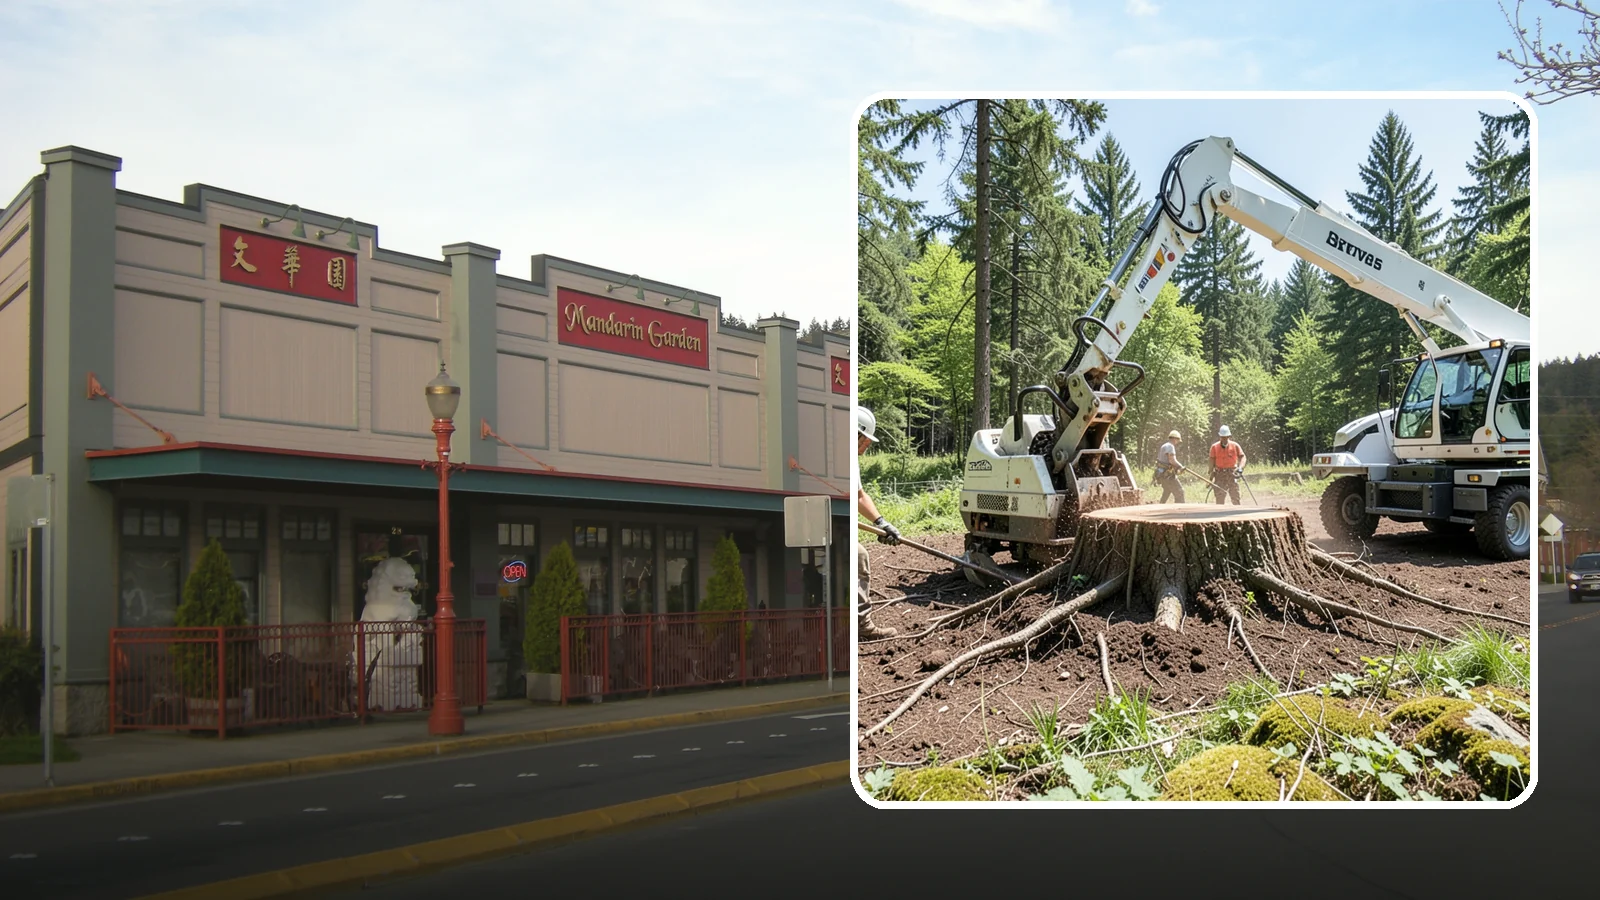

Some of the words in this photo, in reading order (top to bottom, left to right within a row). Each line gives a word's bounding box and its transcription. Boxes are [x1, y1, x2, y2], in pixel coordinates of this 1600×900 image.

[565, 302, 644, 341] Mandarin
[648, 320, 701, 352] Garden
[835, 363, 846, 386] 文
[503, 565, 527, 578] OPEN
